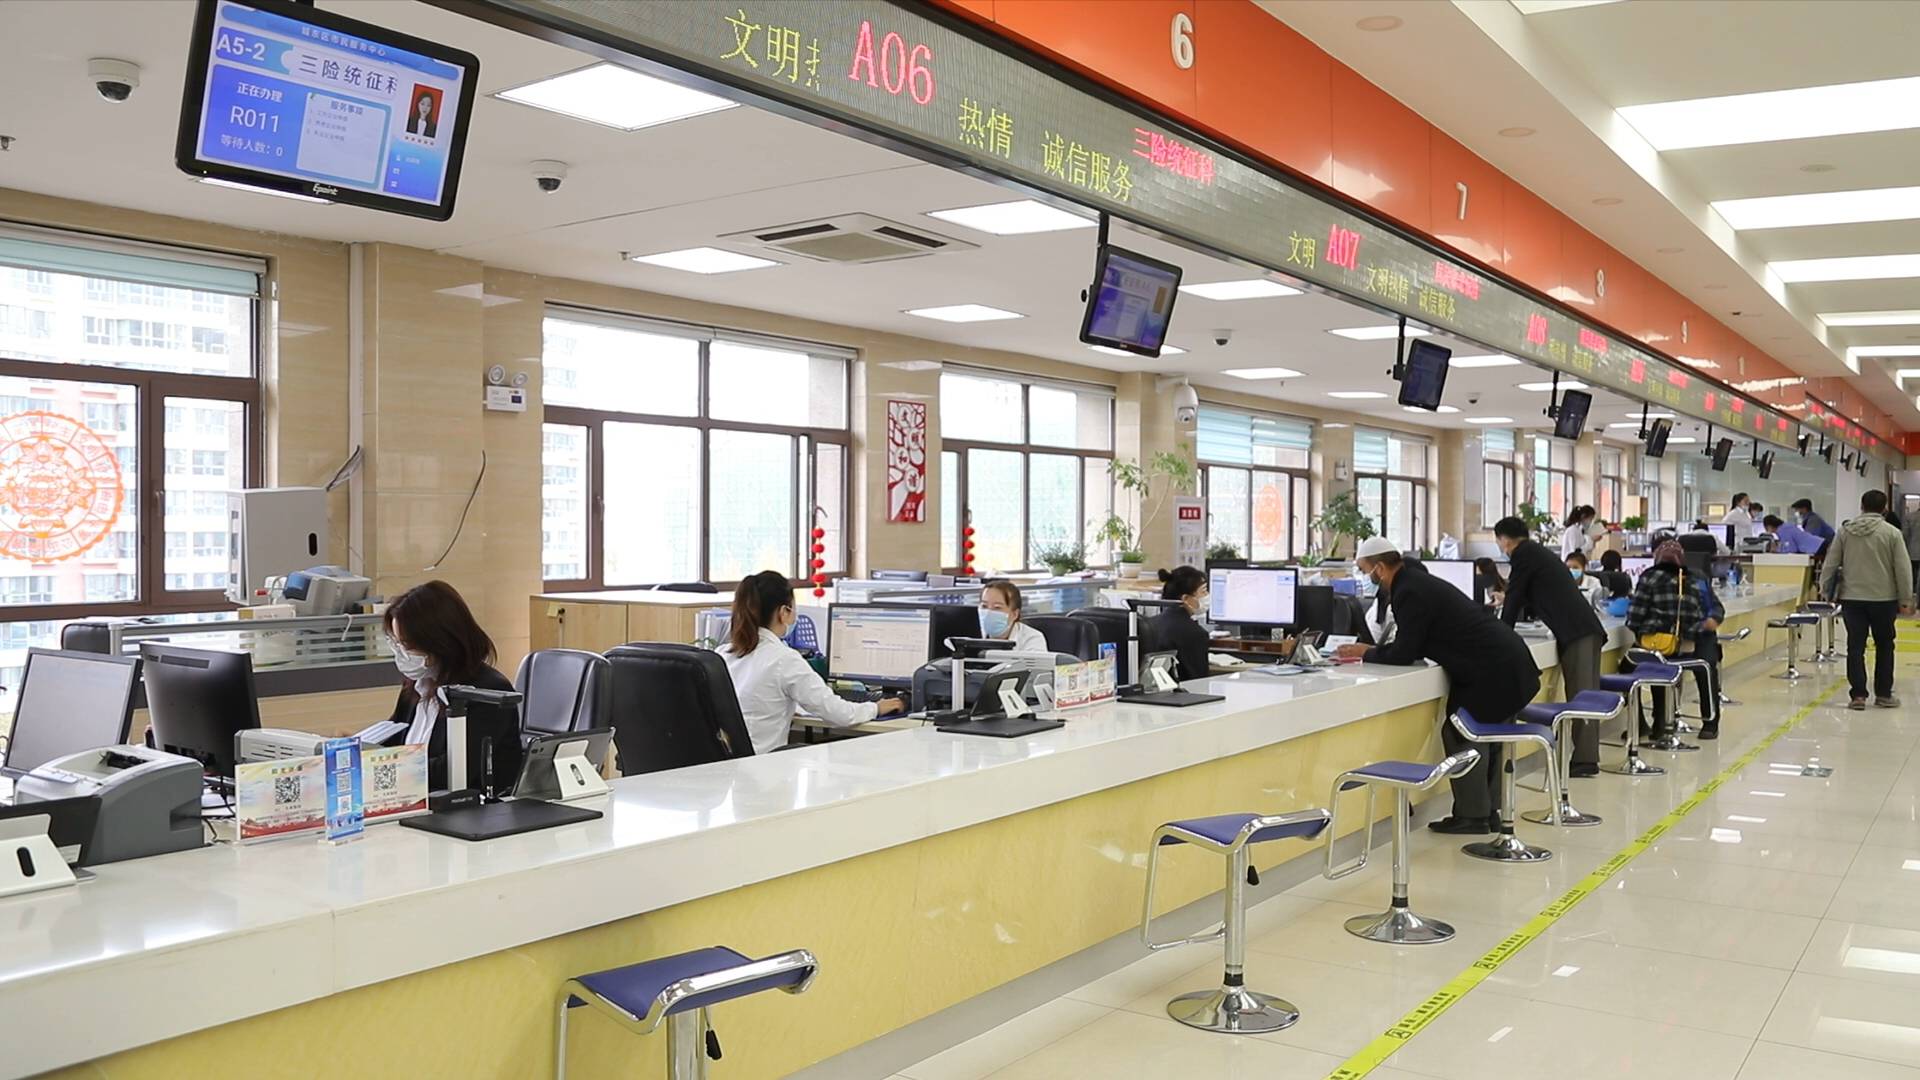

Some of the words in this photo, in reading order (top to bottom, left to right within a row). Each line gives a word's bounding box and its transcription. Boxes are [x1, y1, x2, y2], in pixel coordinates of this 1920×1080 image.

[217, 33, 266, 61] A5-2
[1171, 12, 1194, 69] 6
[849, 20, 936, 105] A06
[236, 81, 284, 103] 正在办理
[230, 105, 280, 133] R011
[958, 97, 1015, 160] 热情
[1041, 129, 1134, 203] 诚信服务
[1132, 127, 1216, 186] 三险统征科
[1456, 182, 1468, 220] 7
[1287, 231, 1317, 270] 文明
[1324, 223, 1361, 272] A07
[1596, 269, 1605, 297] 8
